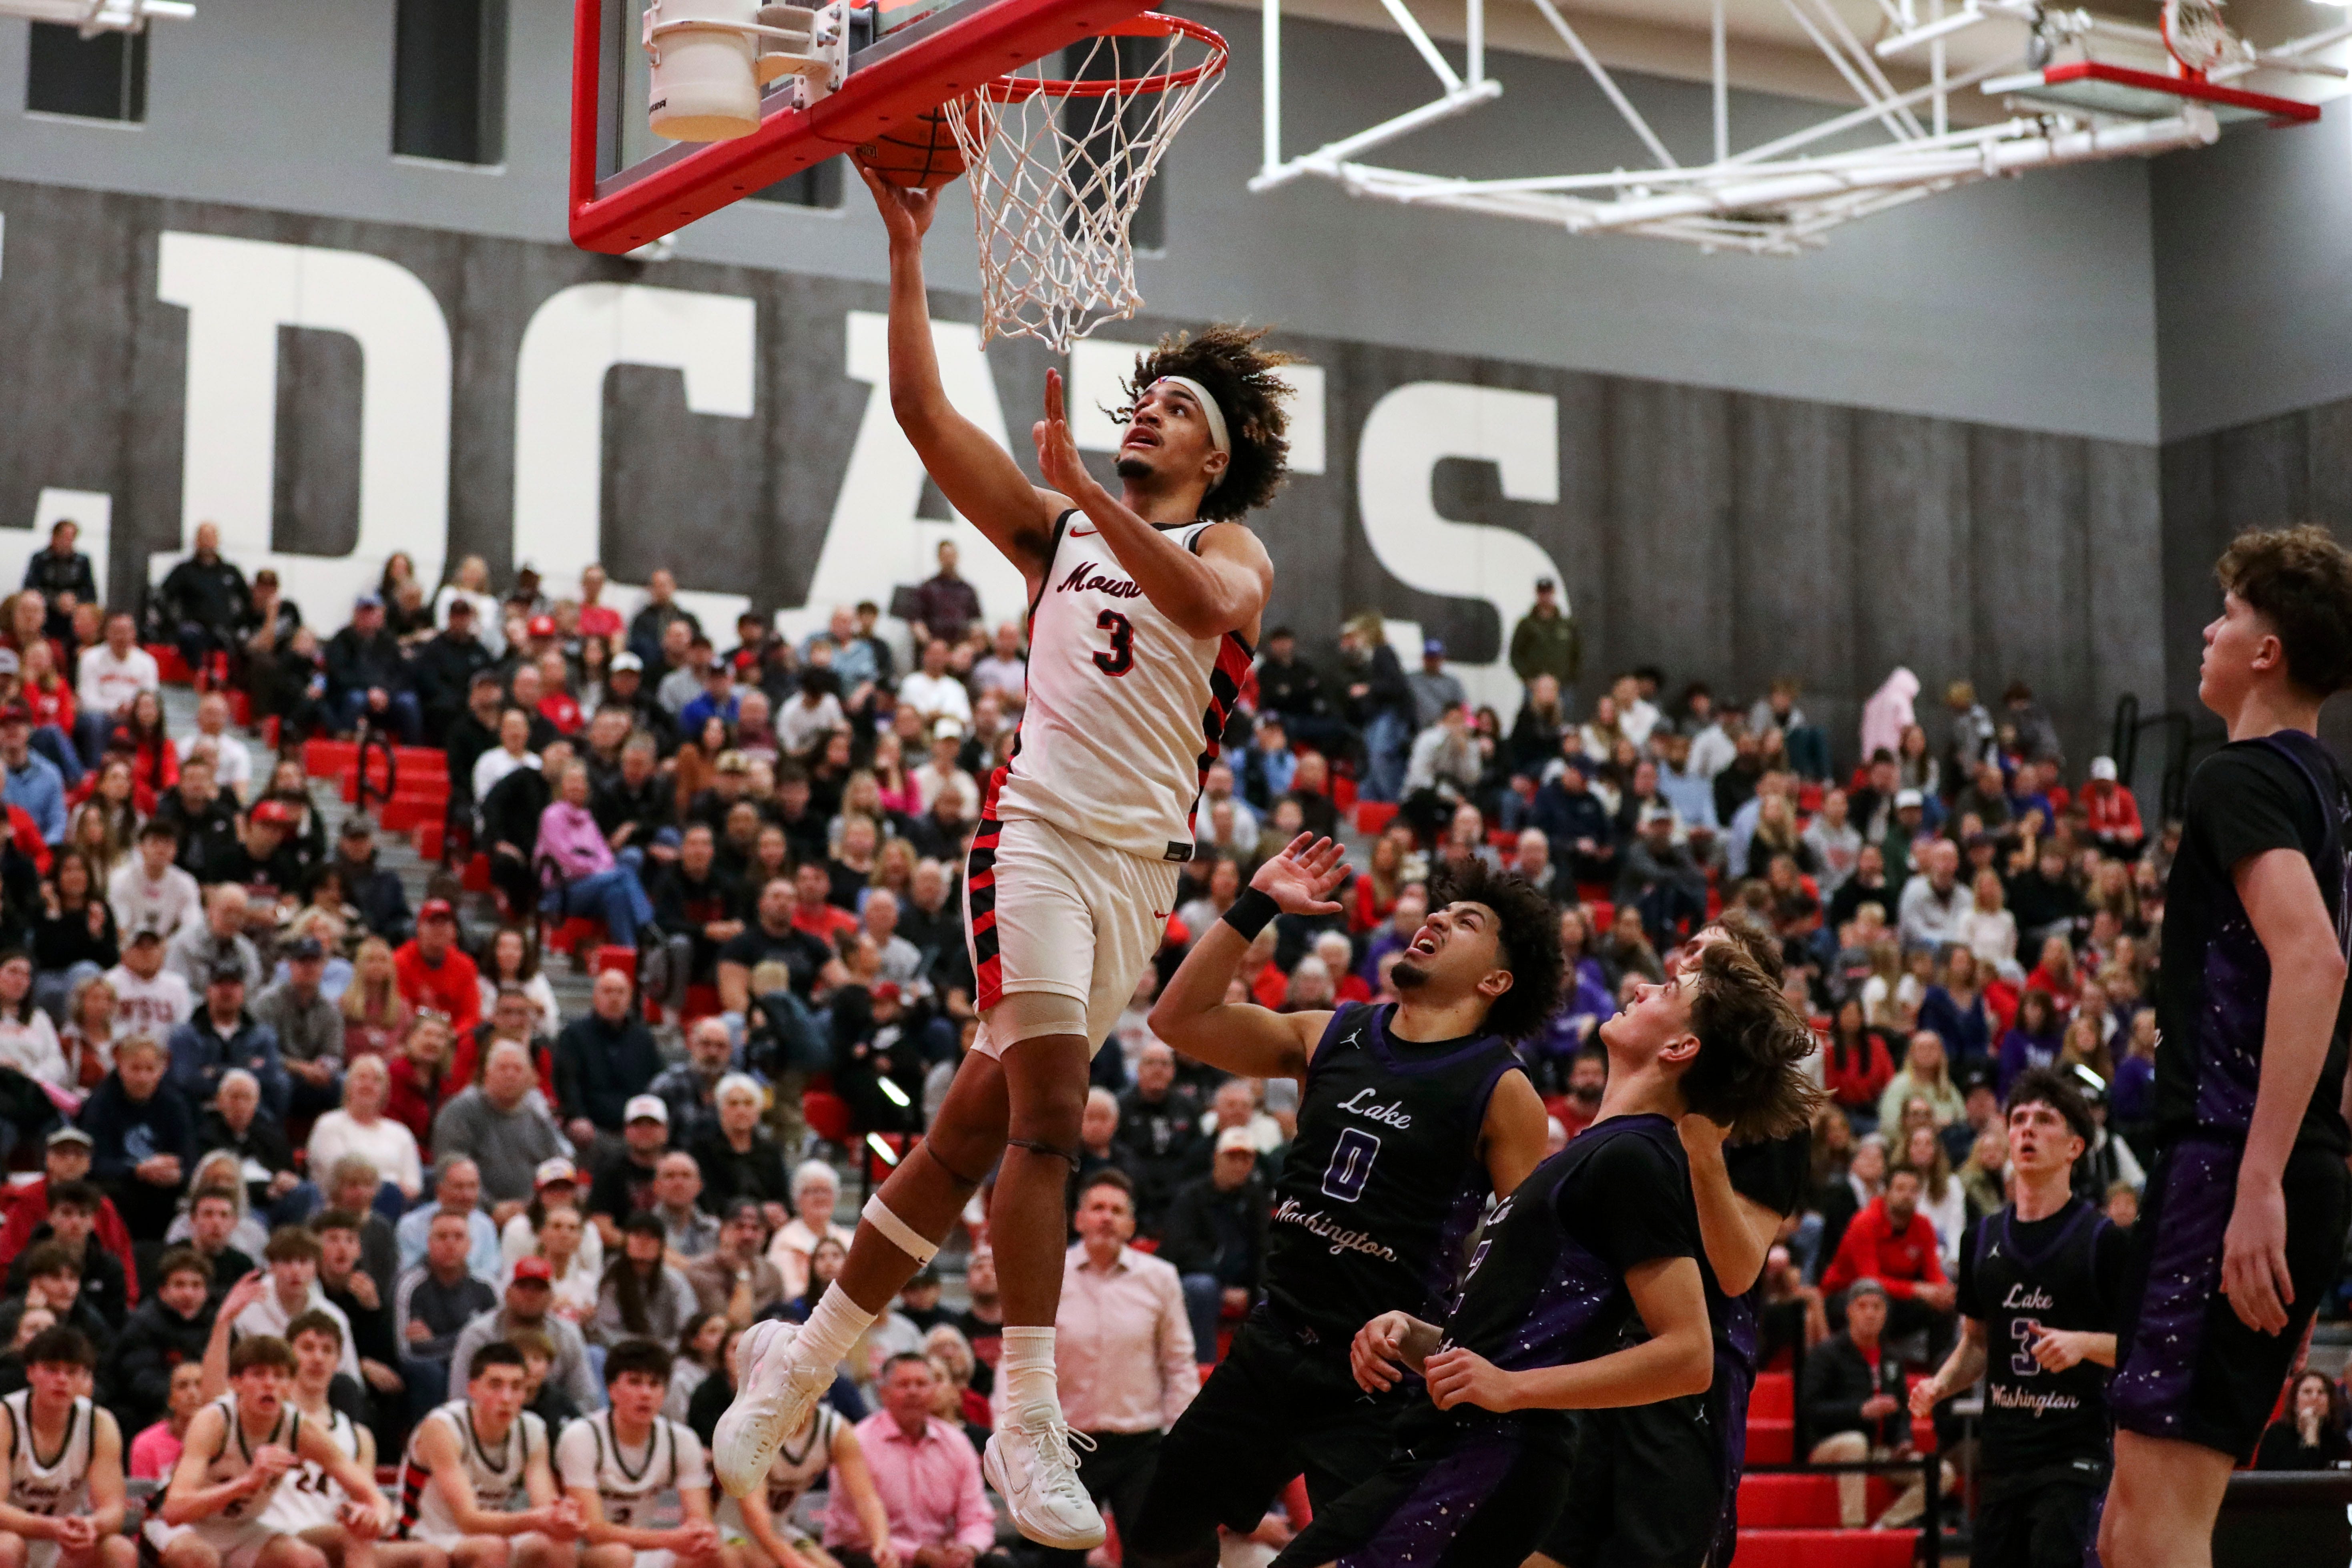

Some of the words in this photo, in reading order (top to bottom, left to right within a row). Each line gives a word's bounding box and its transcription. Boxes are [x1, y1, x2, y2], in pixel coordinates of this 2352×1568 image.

[0, 211, 1571, 740] DCAS
[1092, 608, 1134, 677] 3
[1337, 1088, 1412, 1129] Lake
[1321, 1127, 1381, 1203] 0
[1274, 1195, 1397, 1262] Washington
[2002, 1283, 2054, 1310] Lake
[1990, 1383, 2080, 1418] Washington
